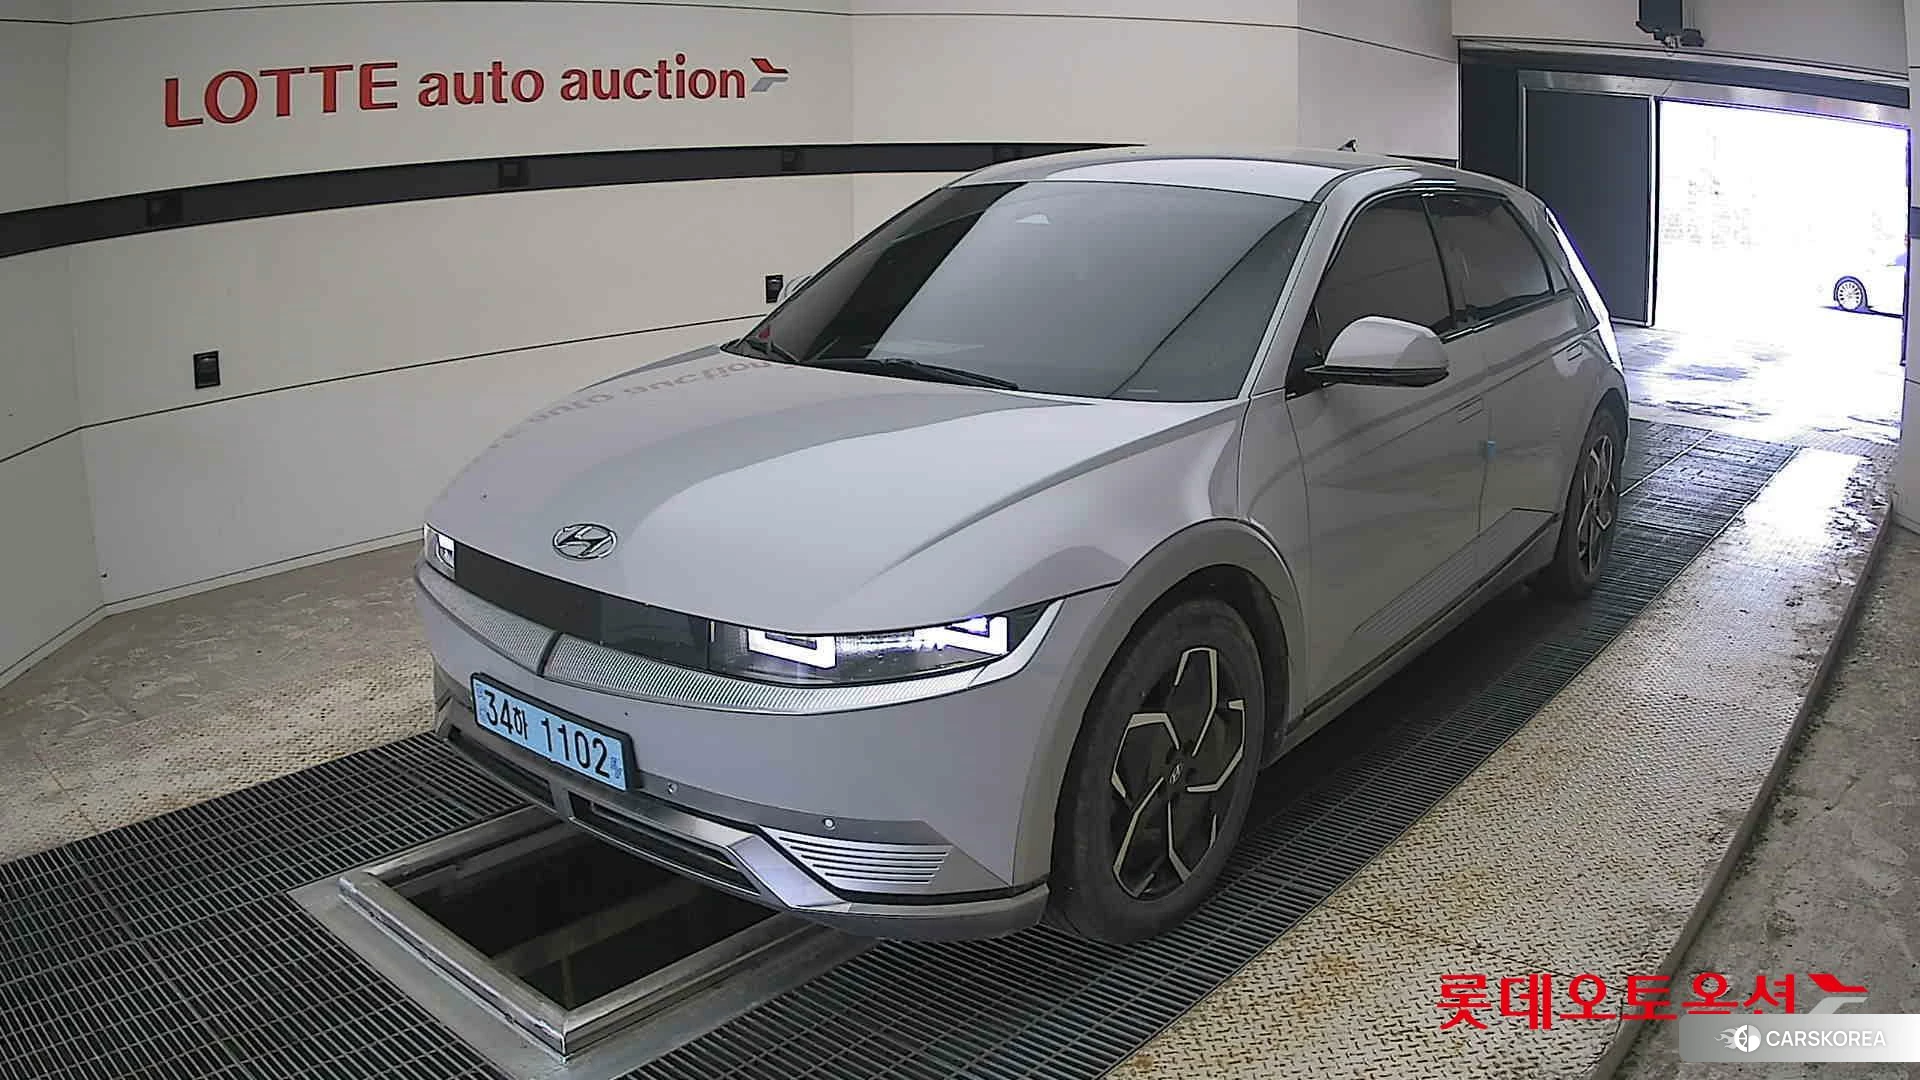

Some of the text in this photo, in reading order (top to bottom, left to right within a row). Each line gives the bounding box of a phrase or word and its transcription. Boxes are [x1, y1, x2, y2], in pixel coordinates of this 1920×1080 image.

[164, 54, 746, 127] LOTTE auto auction
[485, 690, 528, 740] 34하
[541, 717, 610, 778] 1102
